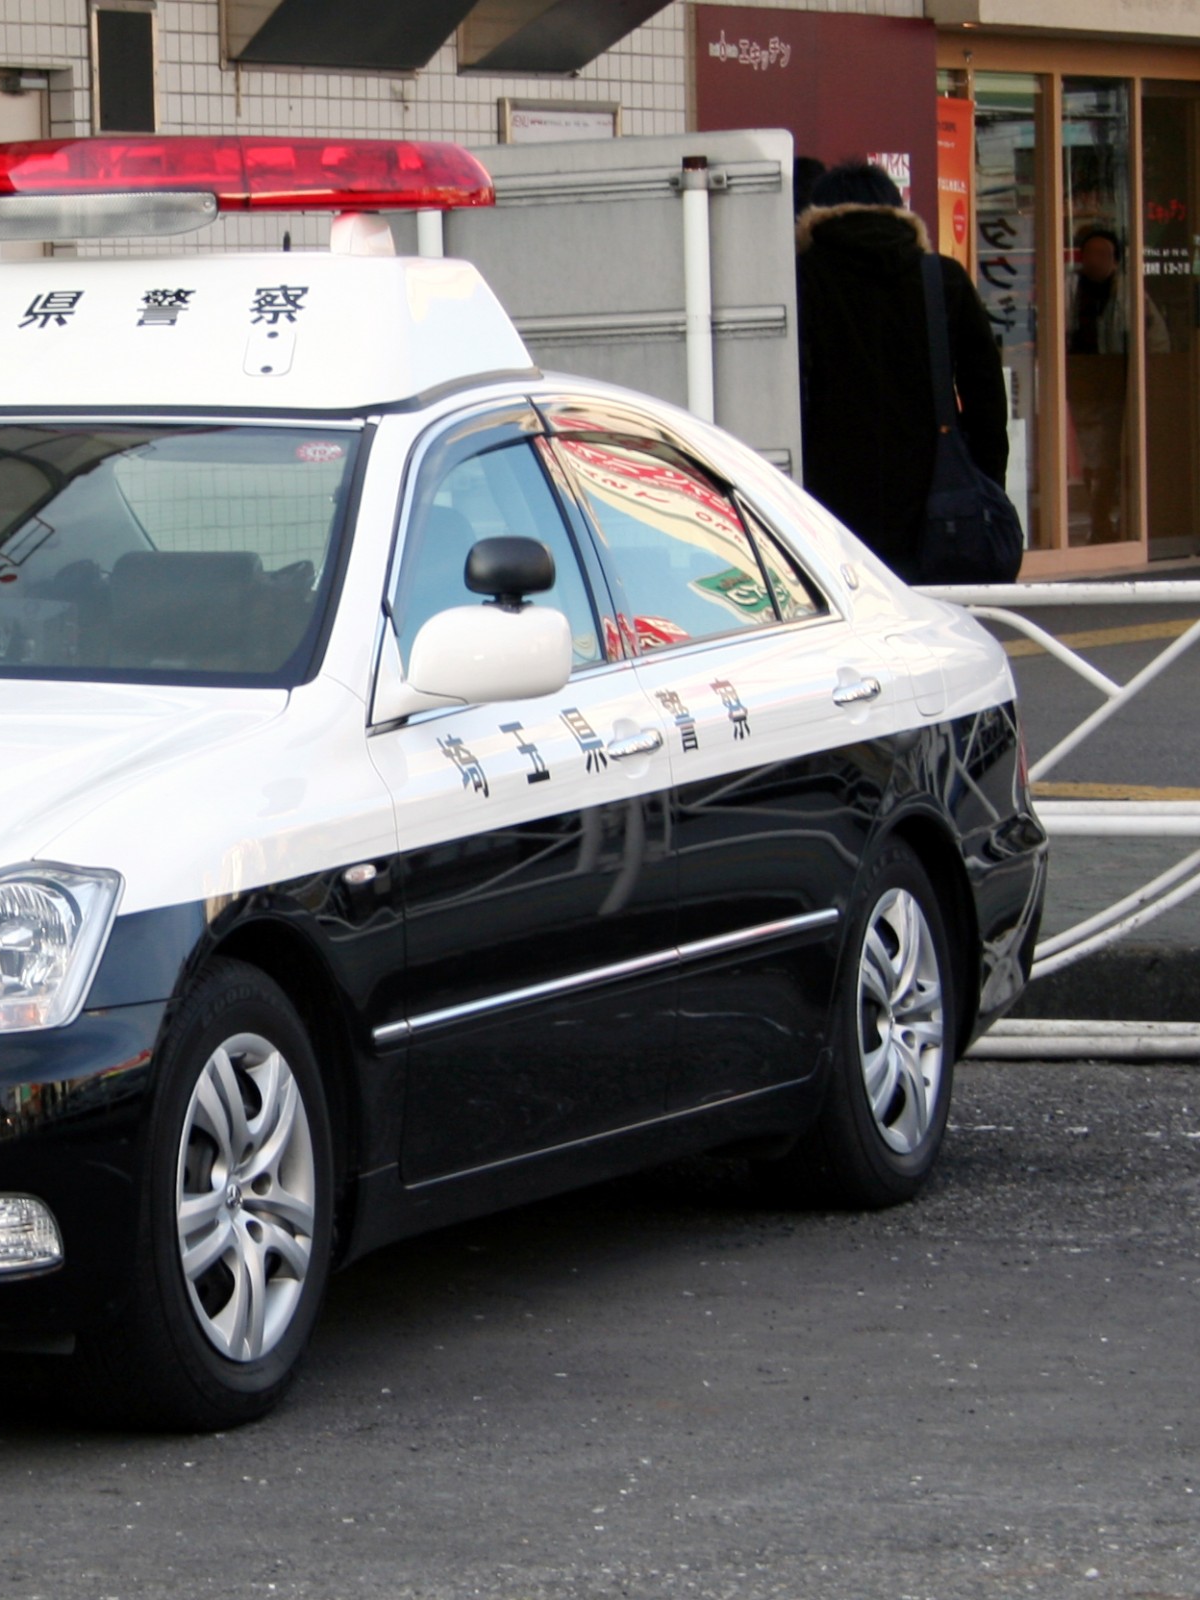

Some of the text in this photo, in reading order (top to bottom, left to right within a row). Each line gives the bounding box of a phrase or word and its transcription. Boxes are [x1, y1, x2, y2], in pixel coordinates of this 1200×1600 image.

[437, 677, 750, 799] 埼玉県警察
